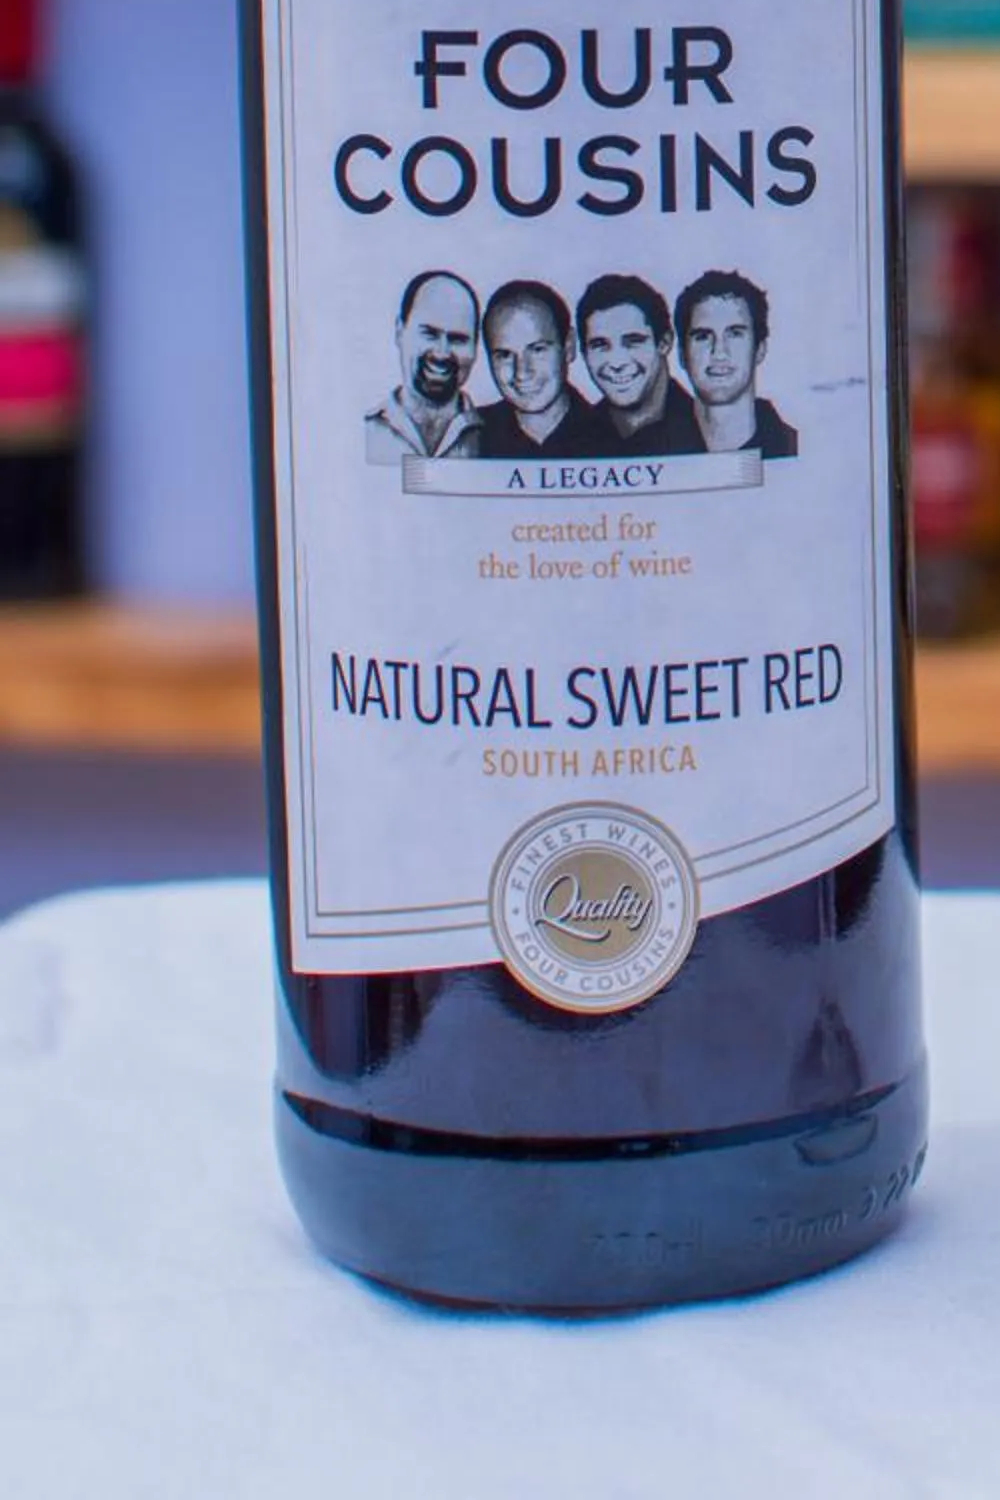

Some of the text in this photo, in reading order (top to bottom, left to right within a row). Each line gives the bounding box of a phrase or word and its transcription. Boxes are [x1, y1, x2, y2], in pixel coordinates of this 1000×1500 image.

[413, 25, 735, 110] FOUR
[333, 125, 818, 218] COUSINS
[507, 463, 665, 490] A LEGACY
[511, 513, 658, 543] created for
[477, 551, 692, 580] the love of wine
[330, 642, 844, 730] NATURAL SWEET RED
[482, 744, 698, 778] SOUTH AFRICA
[511, 822, 677, 893] FINEST WINES
[534, 874, 654, 943] Quality
[515, 927, 675, 993] FOUR COUSINS
